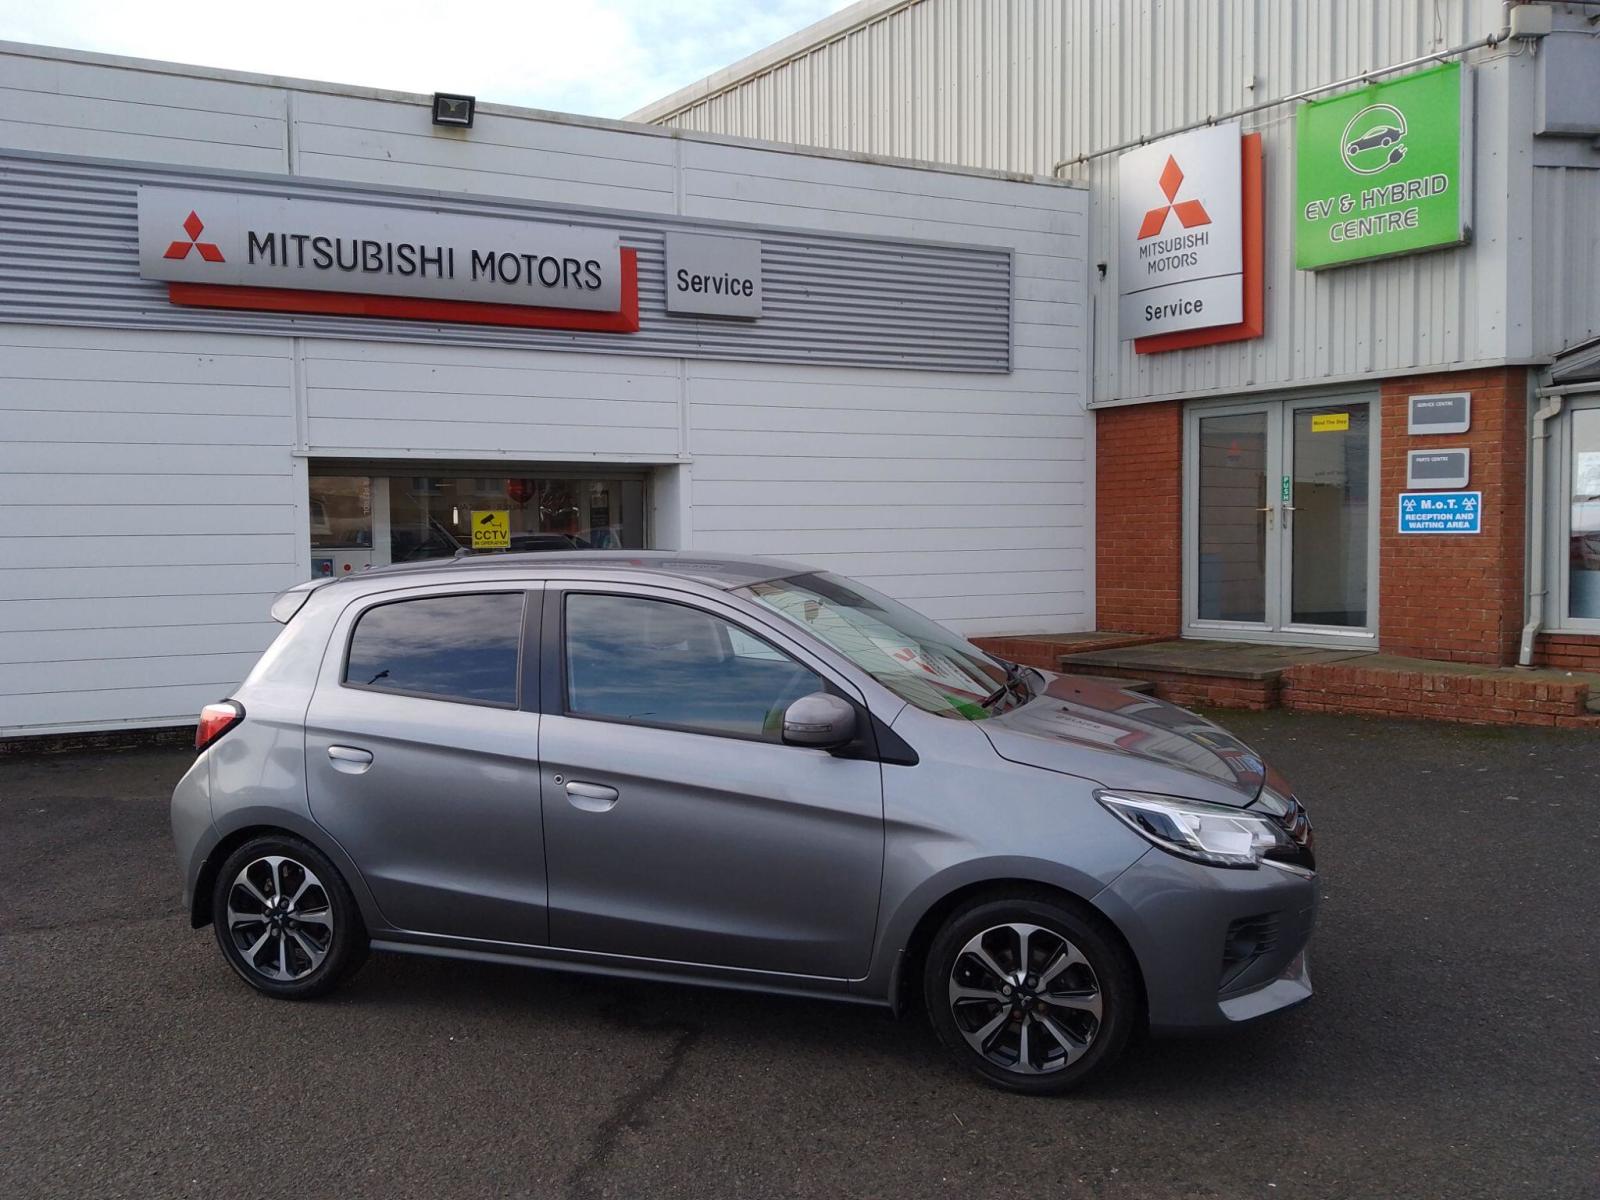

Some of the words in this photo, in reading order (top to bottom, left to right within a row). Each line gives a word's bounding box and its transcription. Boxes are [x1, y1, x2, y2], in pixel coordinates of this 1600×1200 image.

[1305, 198, 1334, 220] EV
[1340, 195, 1354, 213] &
[1361, 173, 1448, 208] HYBRID
[1330, 207, 1419, 242] CENTRE
[1139, 232, 1209, 259] MITSUBISHI
[248, 231, 453, 279] MITSUBISHI
[472, 251, 601, 290] MOTORS
[1147, 252, 1198, 274] MOTORS
[677, 268, 754, 298] Service
[1144, 298, 1204, 321] Service
[1421, 499, 1458, 509] M.o.T.
[1405, 513, 1453, 521] RECEPTION
[474, 530, 507, 540] CCTV
